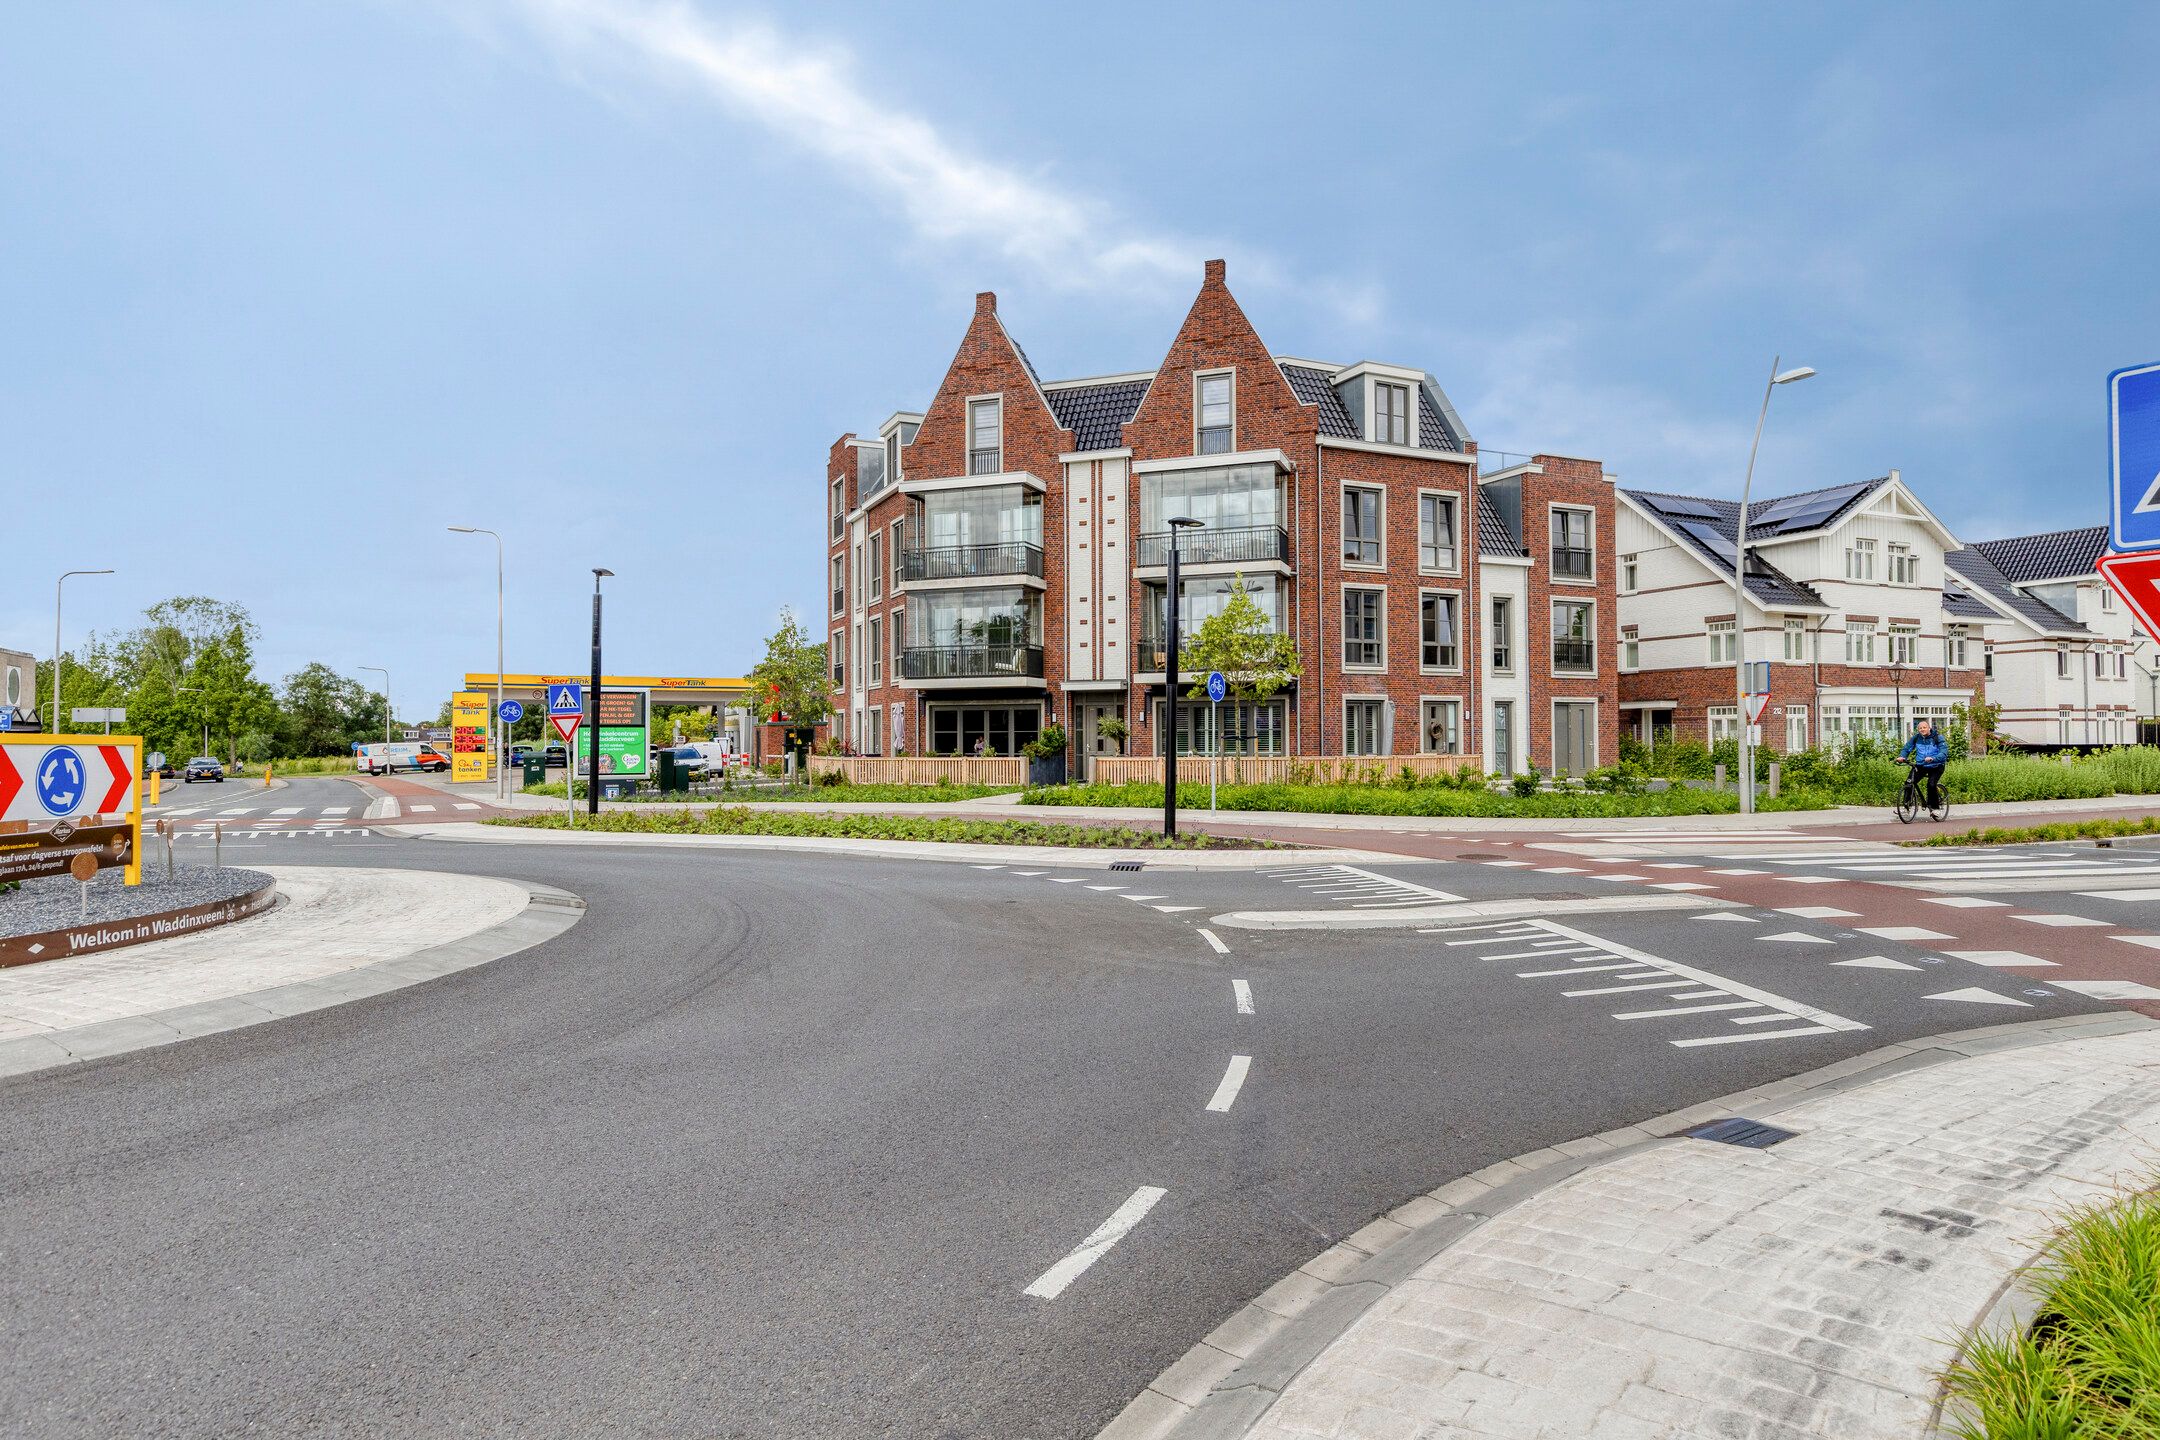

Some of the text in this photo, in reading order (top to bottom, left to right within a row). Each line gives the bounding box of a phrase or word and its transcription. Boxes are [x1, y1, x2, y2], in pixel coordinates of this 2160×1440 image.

[14, 854, 30, 862] voor
[31, 850, 62, 862] dagverse
[70, 929, 134, 950] Welkom
[137, 924, 150, 938] in
[152, 910, 225, 935] Waddinxveen!
